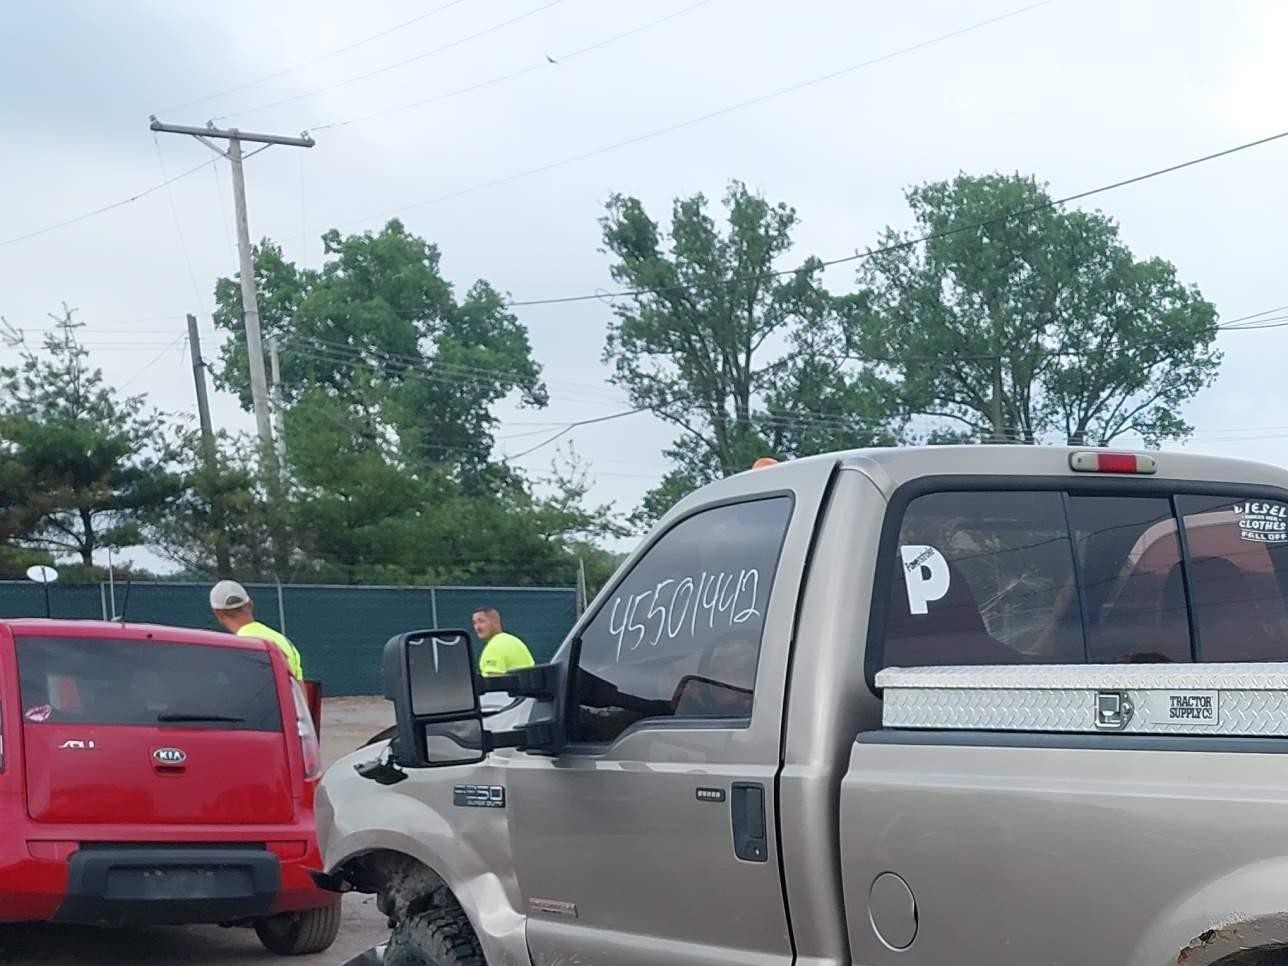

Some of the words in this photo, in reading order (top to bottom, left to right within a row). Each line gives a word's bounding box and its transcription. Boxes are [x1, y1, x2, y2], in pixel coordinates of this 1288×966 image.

[1239, 520, 1287, 530] CLOTHES
[1241, 531, 1267, 540] FALL
[1267, 533, 1287, 541] OFF
[609, 568, 760, 664] 45501442
[1169, 695, 1212, 707] TRACTOR
[1169, 707, 1202, 719] SUPPLY
[159, 750, 182, 761] KIA
